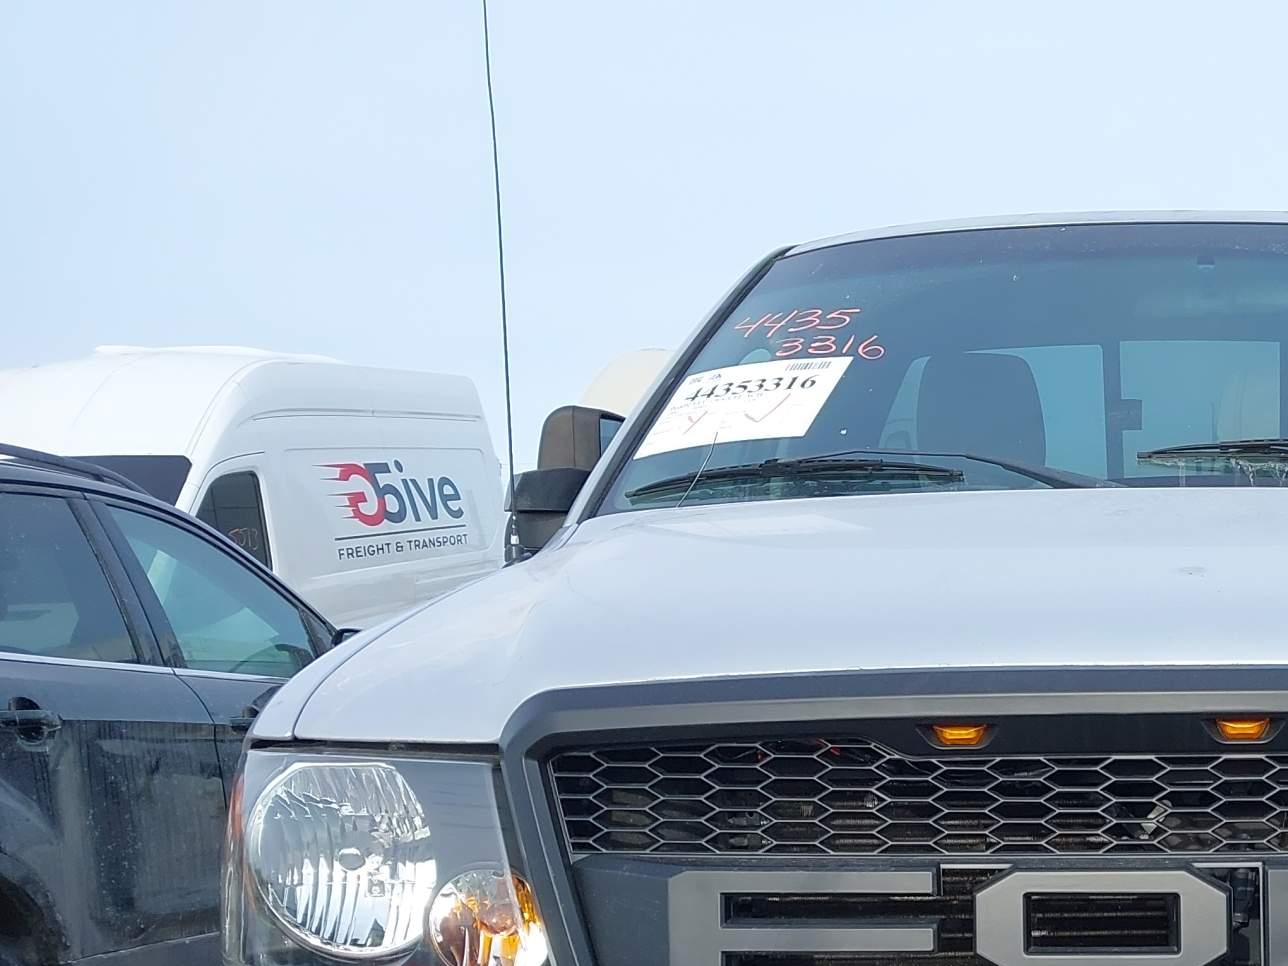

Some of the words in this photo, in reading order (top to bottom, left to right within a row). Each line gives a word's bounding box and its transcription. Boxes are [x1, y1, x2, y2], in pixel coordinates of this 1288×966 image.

[734, 308, 861, 338] 4435
[775, 334, 885, 360] 3316
[686, 374, 820, 402] 44353316
[338, 543, 391, 560] FREIGHT
[395, 541, 404, 553] &
[407, 533, 469, 552] TRANSPORT
